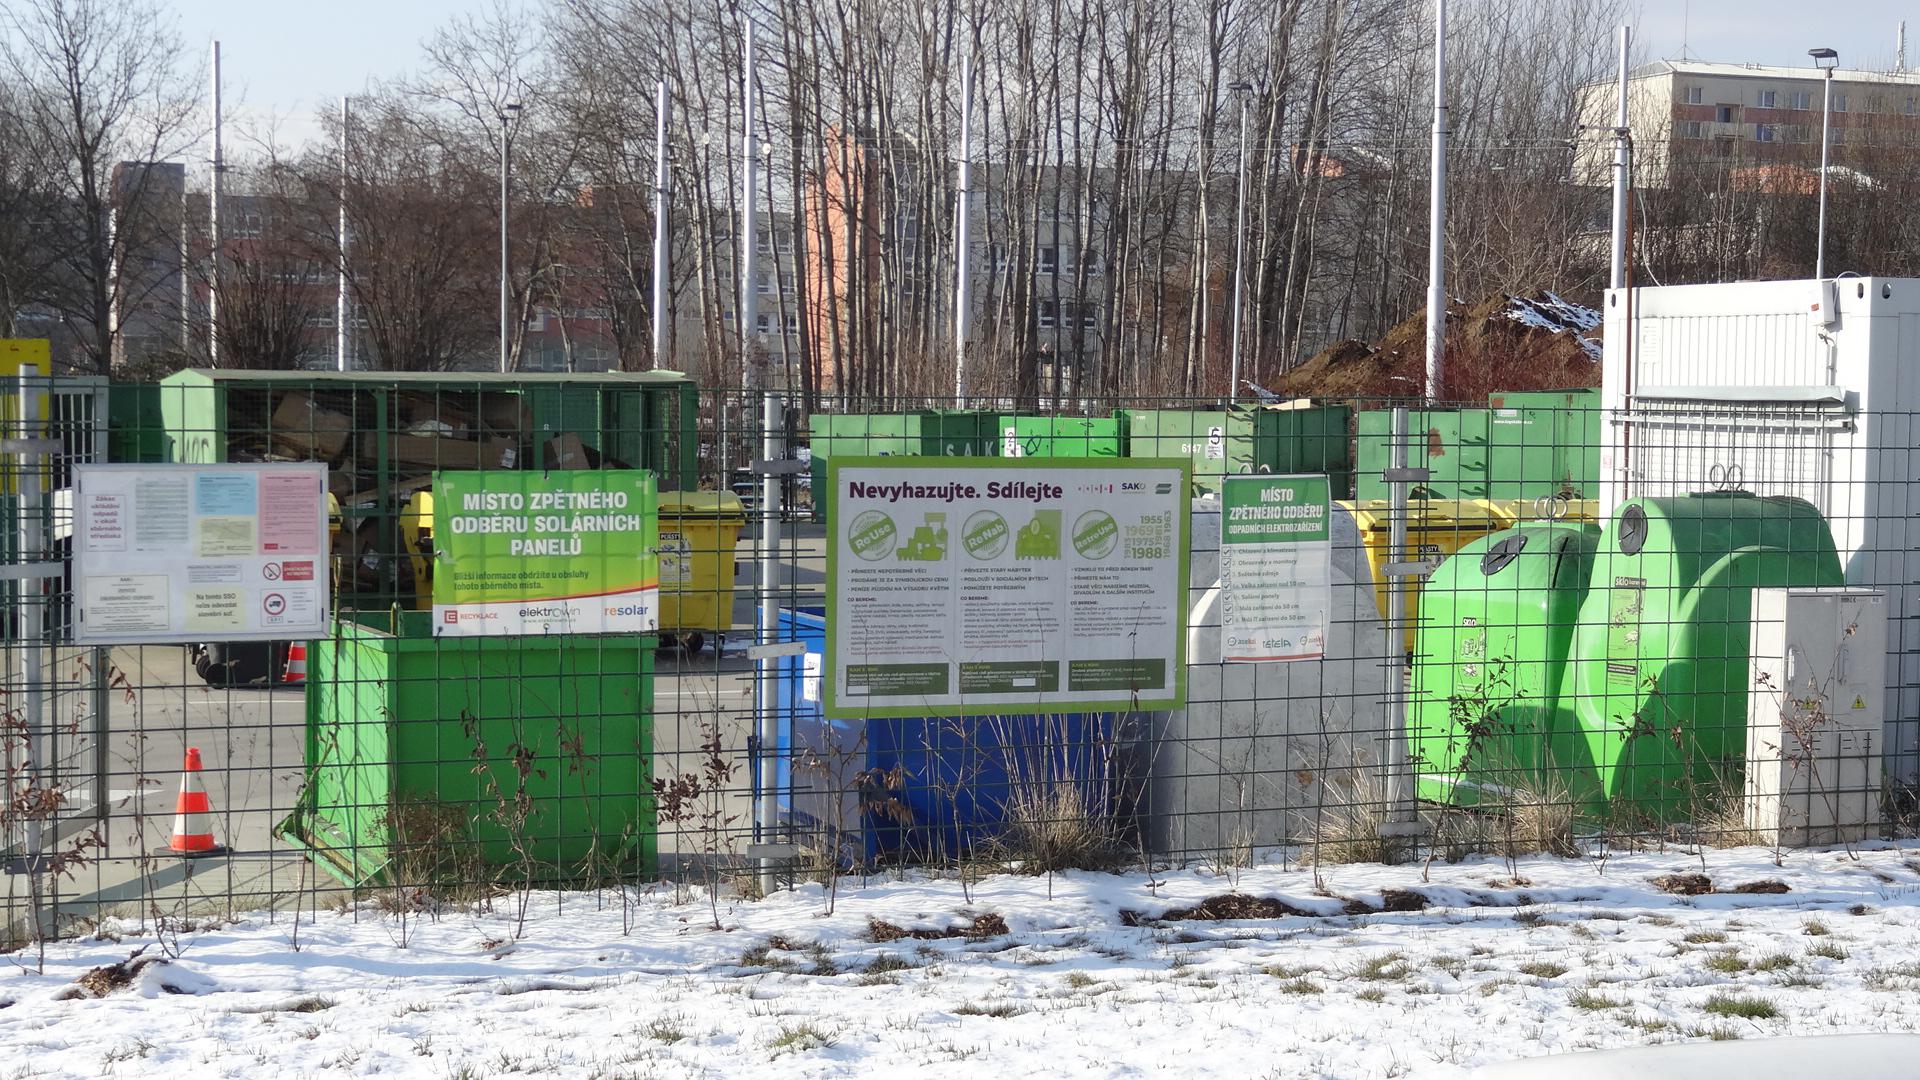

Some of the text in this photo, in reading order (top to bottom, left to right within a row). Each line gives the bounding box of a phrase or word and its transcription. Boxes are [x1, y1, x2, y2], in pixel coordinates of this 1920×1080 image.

[1210, 428, 1220, 445] 5
[463, 488, 628, 510] MÍSTO ZPĚTNÉHO
[849, 481, 981, 503] Nevyhazujte.
[987, 481, 1063, 503] Sdílejte
[1261, 487, 1294, 502] MÍSTO
[1229, 502, 1323, 520] ZPĚTNÉHO ODBĚRU
[451, 512, 640, 534] ODBĚRU SOLÁRNÍCH
[1140, 515, 1163, 525] 1955
[1228, 520, 1323, 534] ODPADNÍCH ELEKTROZAŘÍZENÍ
[968, 521, 1006, 550] ReNab
[1131, 537, 1155, 546] 1975
[511, 533, 582, 556] PANELŮ
[1131, 547, 1163, 559] 1988
[476, 571, 517, 580] informace
[518, 570, 550, 580] obdržíte
[558, 569, 589, 580] obsluhy
[454, 580, 544, 590] tohoto sběrného místa.
[459, 612, 499, 620] RECYKLACE
[518, 606, 581, 619] elektrowin
[604, 604, 649, 617] resolar
